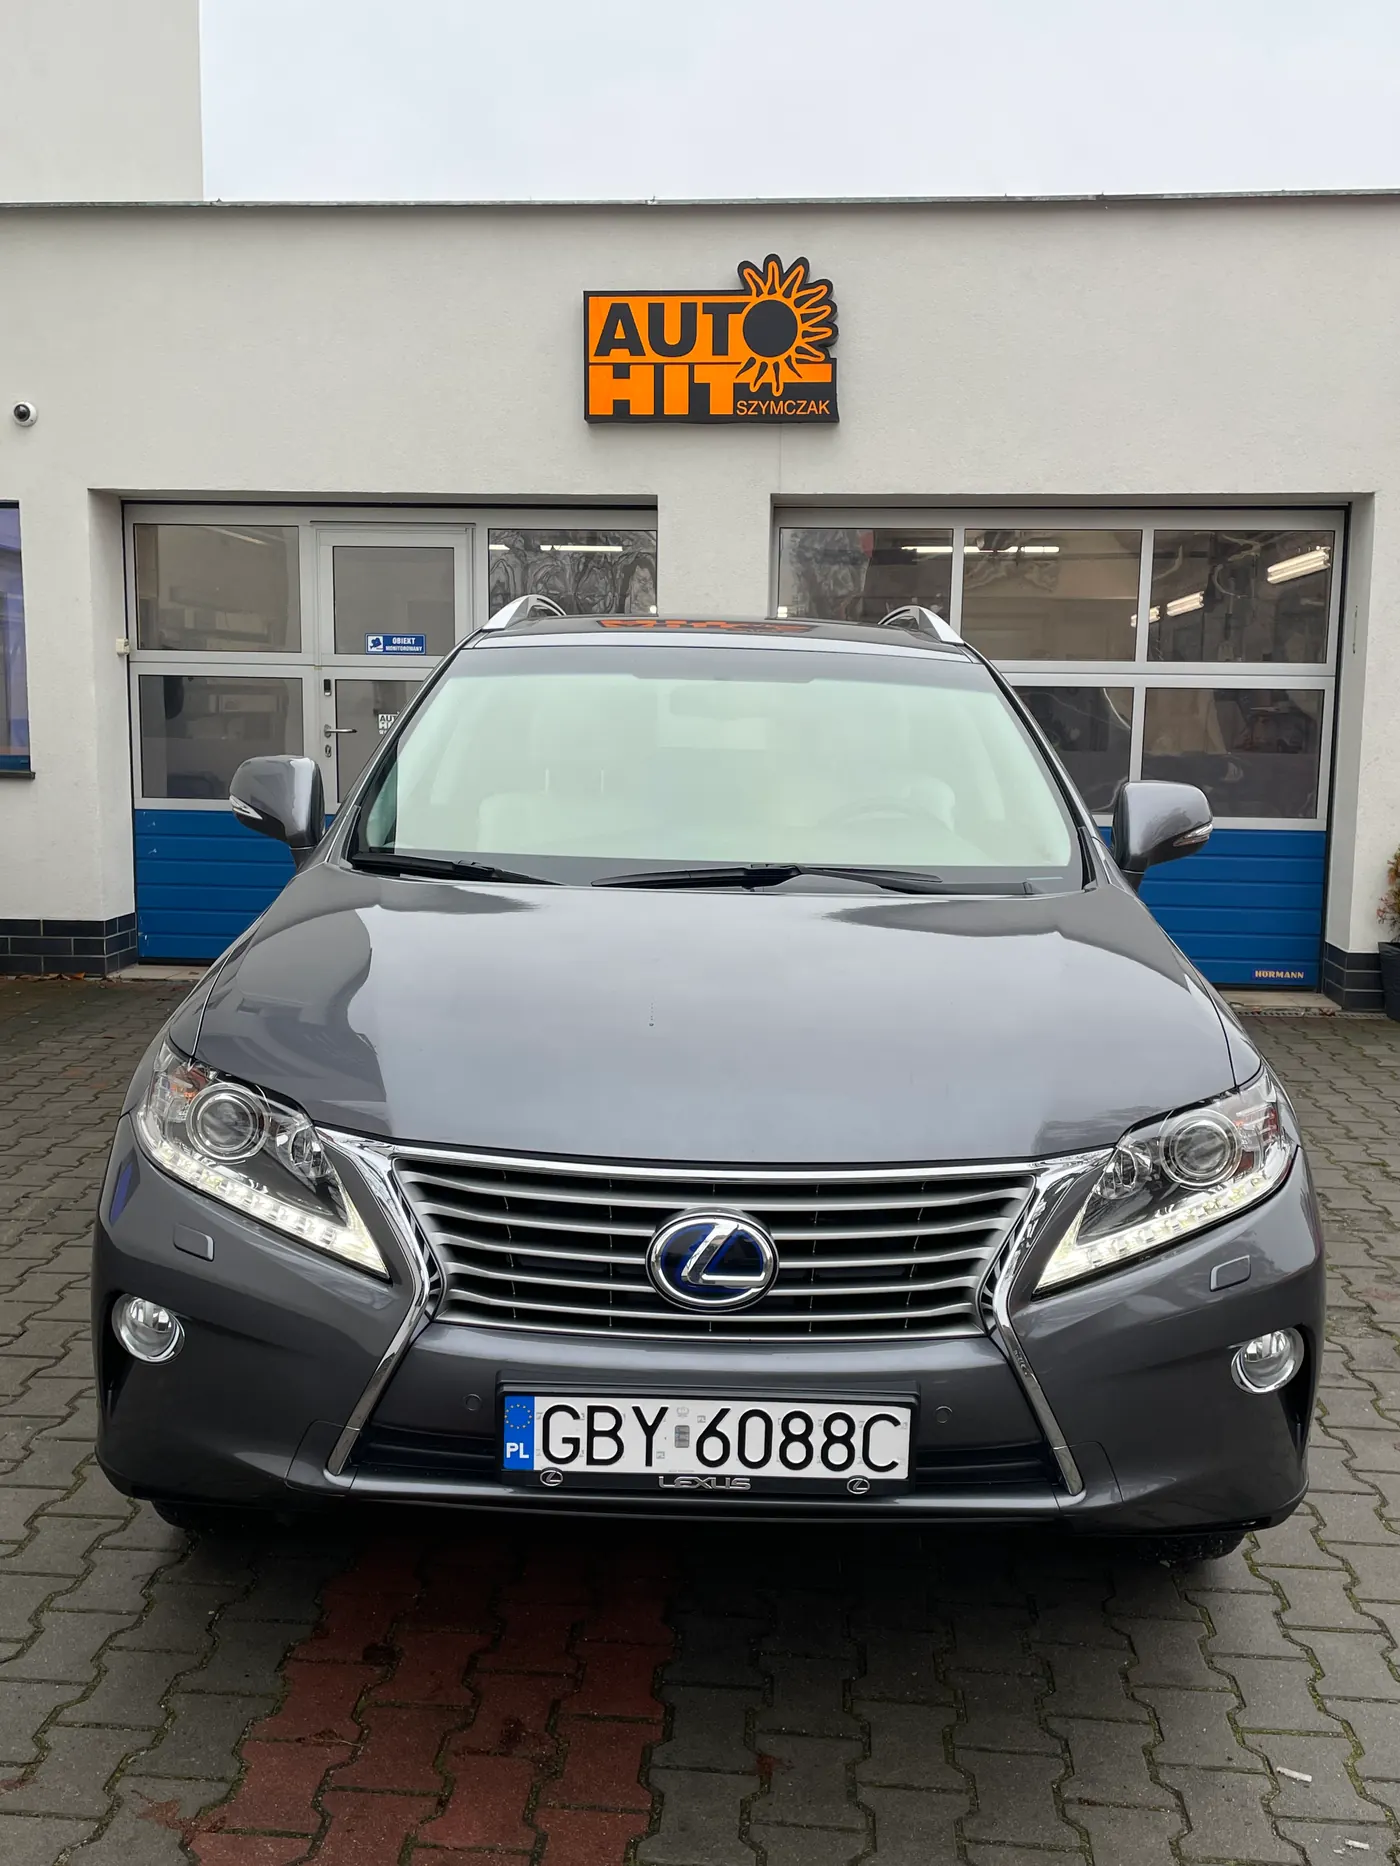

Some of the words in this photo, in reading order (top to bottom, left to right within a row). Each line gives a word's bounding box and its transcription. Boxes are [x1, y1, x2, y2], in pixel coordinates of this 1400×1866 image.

[593, 299, 798, 357] AUTO
[588, 364, 735, 415] HIT
[735, 400, 831, 416] SZYMCZAK
[392, 637, 416, 645] OBIEKT
[541, 1404, 669, 1469] GBY
[696, 1408, 901, 1473] 6088C
[506, 1442, 530, 1459] PL
[658, 1475, 752, 1491] LEXUS
